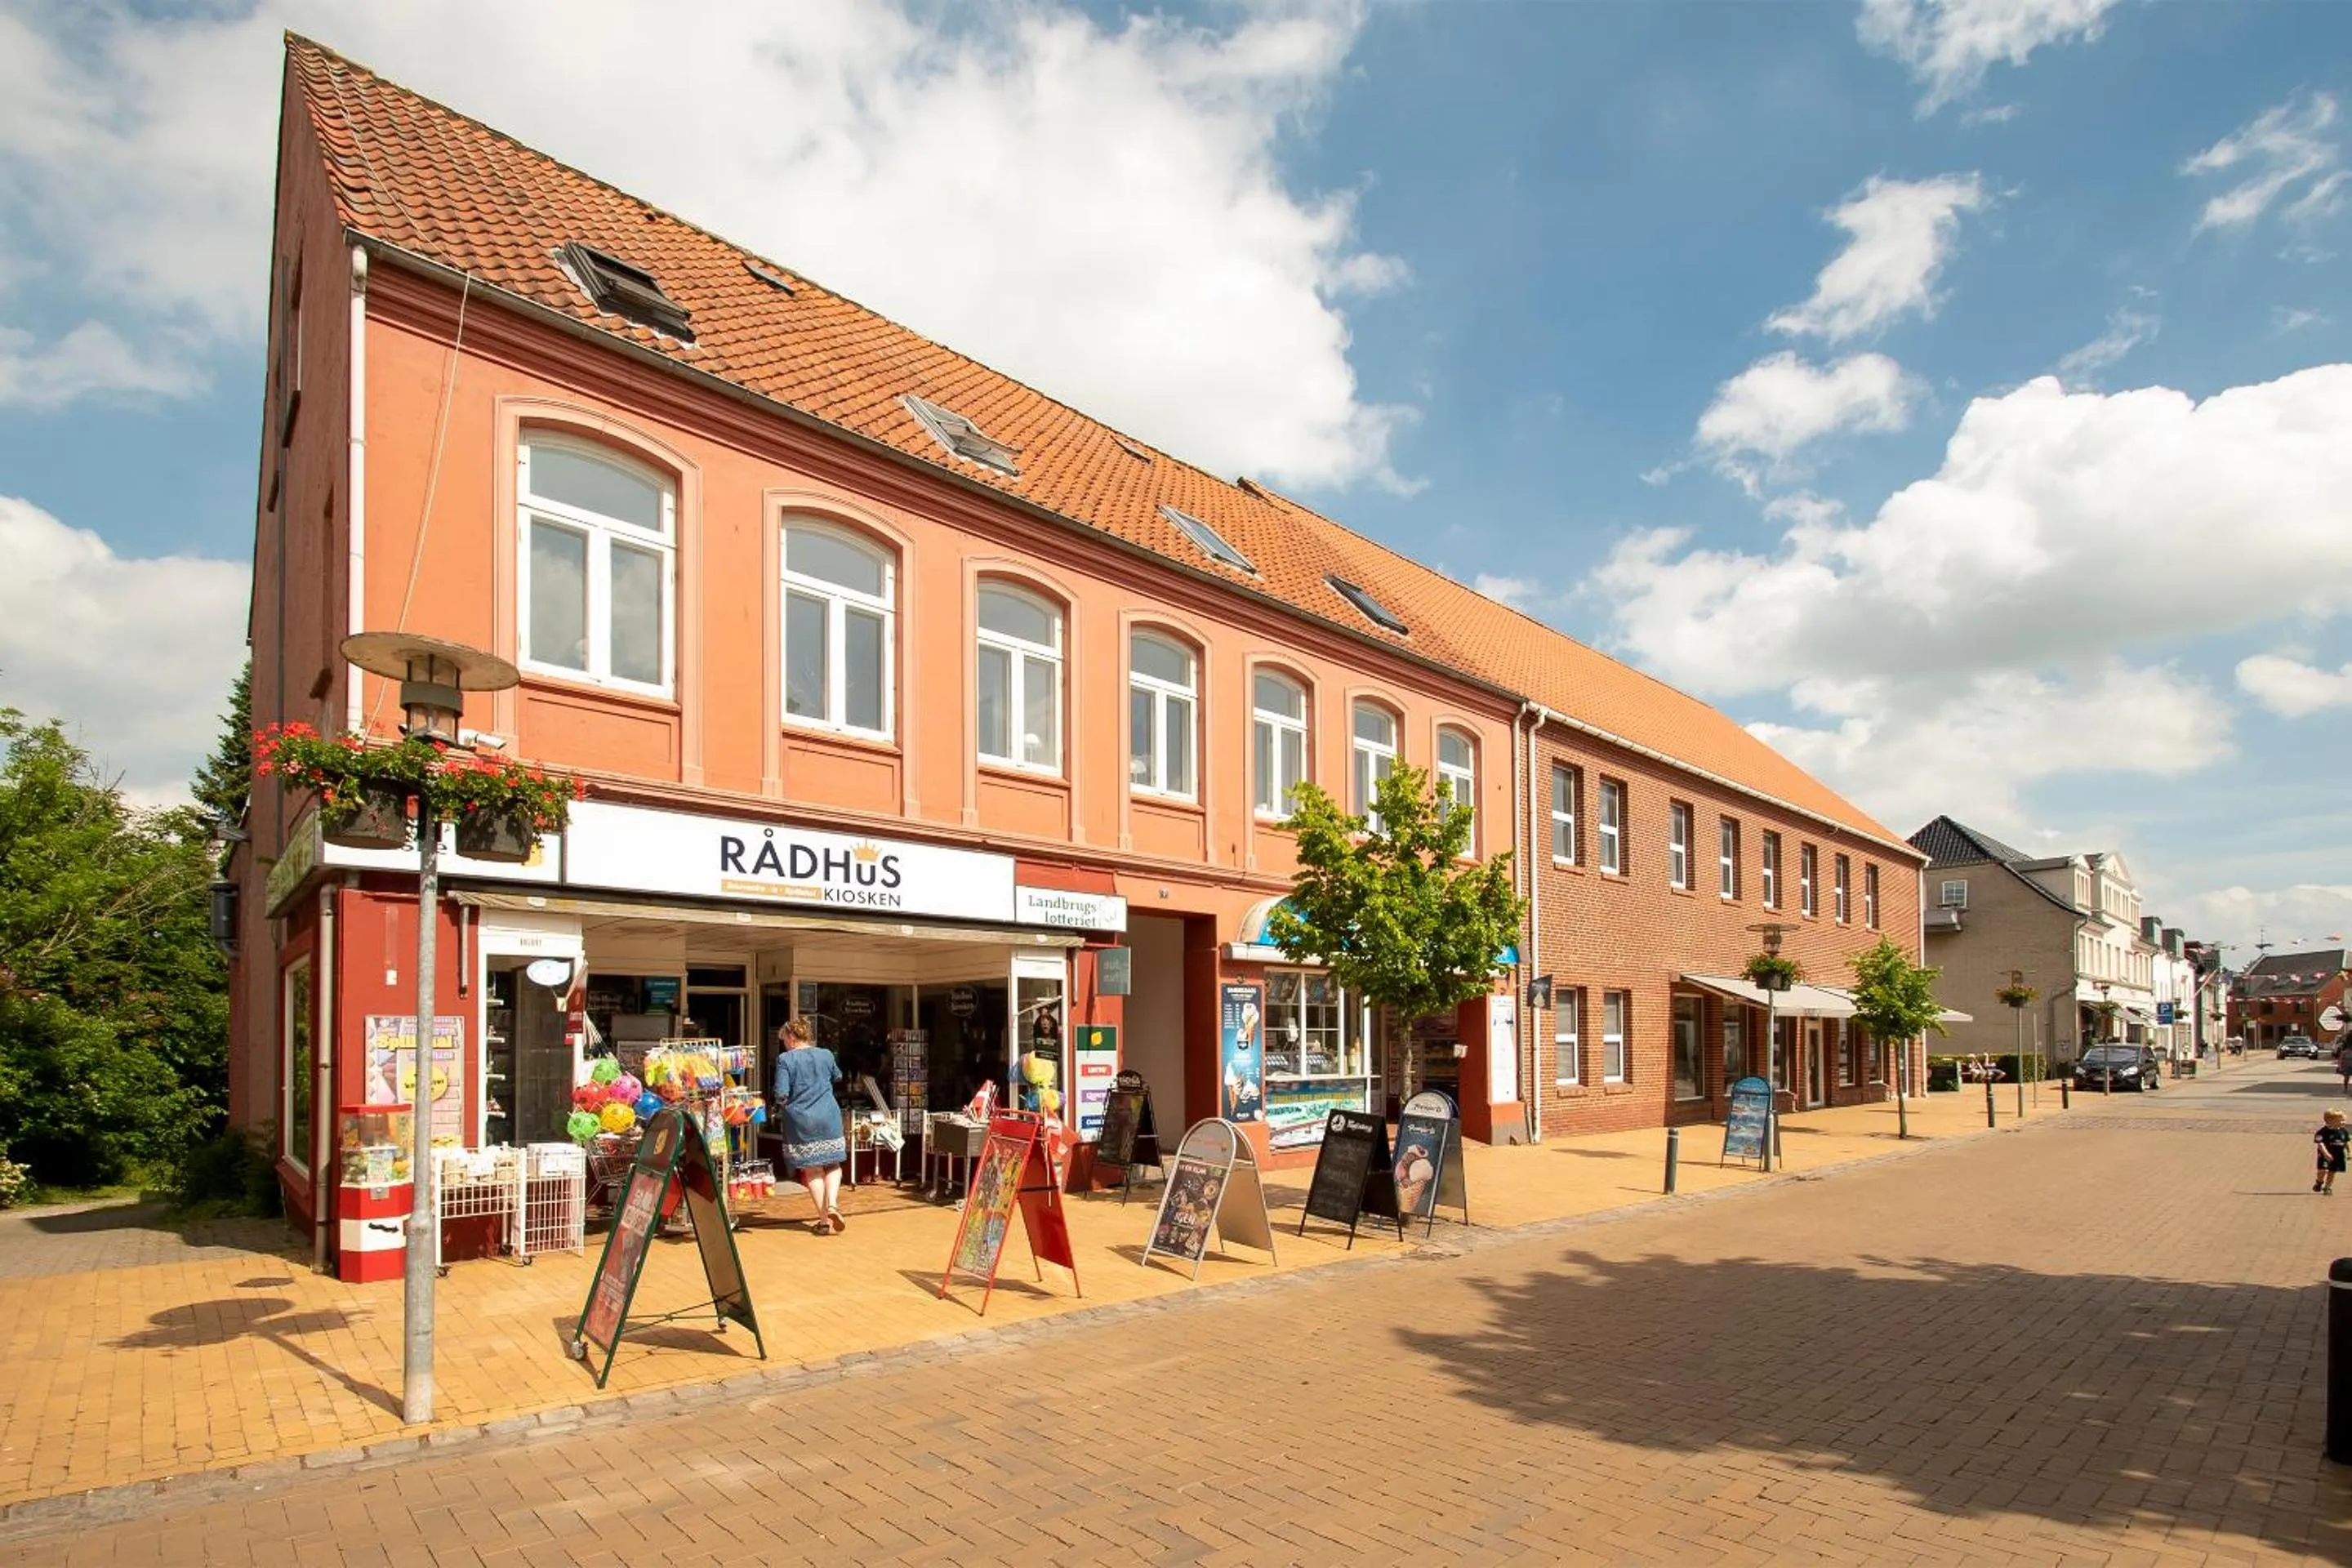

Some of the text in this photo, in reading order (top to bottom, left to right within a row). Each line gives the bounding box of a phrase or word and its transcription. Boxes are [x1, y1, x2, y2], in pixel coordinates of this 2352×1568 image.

[824, 889, 901, 906] KIOSKEN
[1029, 895, 1097, 915] Landbrugs
[1045, 911, 1096, 927] lotteriet
[2160, 1004, 2170, 1013] P
